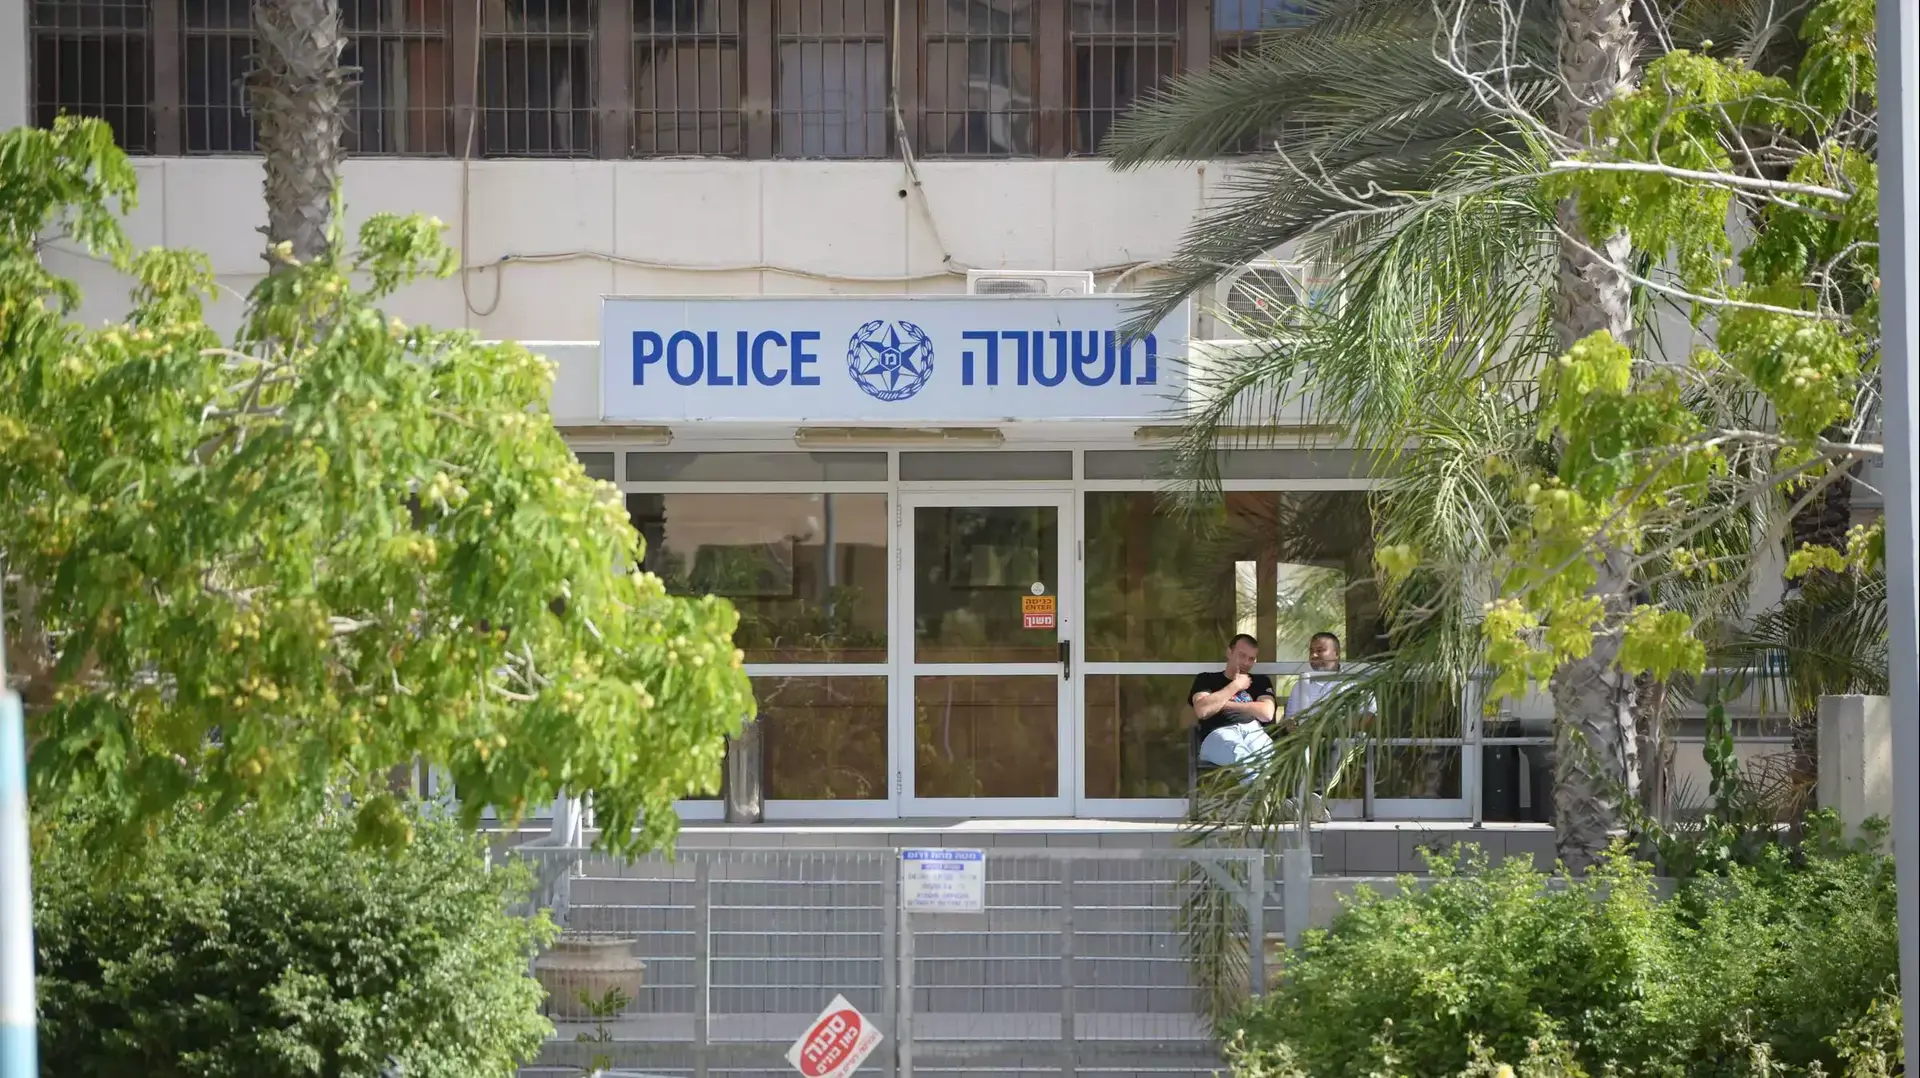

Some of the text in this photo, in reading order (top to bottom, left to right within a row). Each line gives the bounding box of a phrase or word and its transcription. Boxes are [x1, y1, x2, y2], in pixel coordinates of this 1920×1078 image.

[632, 330, 821, 387] POLICE
[962, 330, 1157, 387] משטרה
[1025, 616, 1052, 627] משוך
[804, 1014, 847, 1063] סכנה
[838, 1026, 859, 1049] כאן
[816, 1046, 842, 1074] בונים
